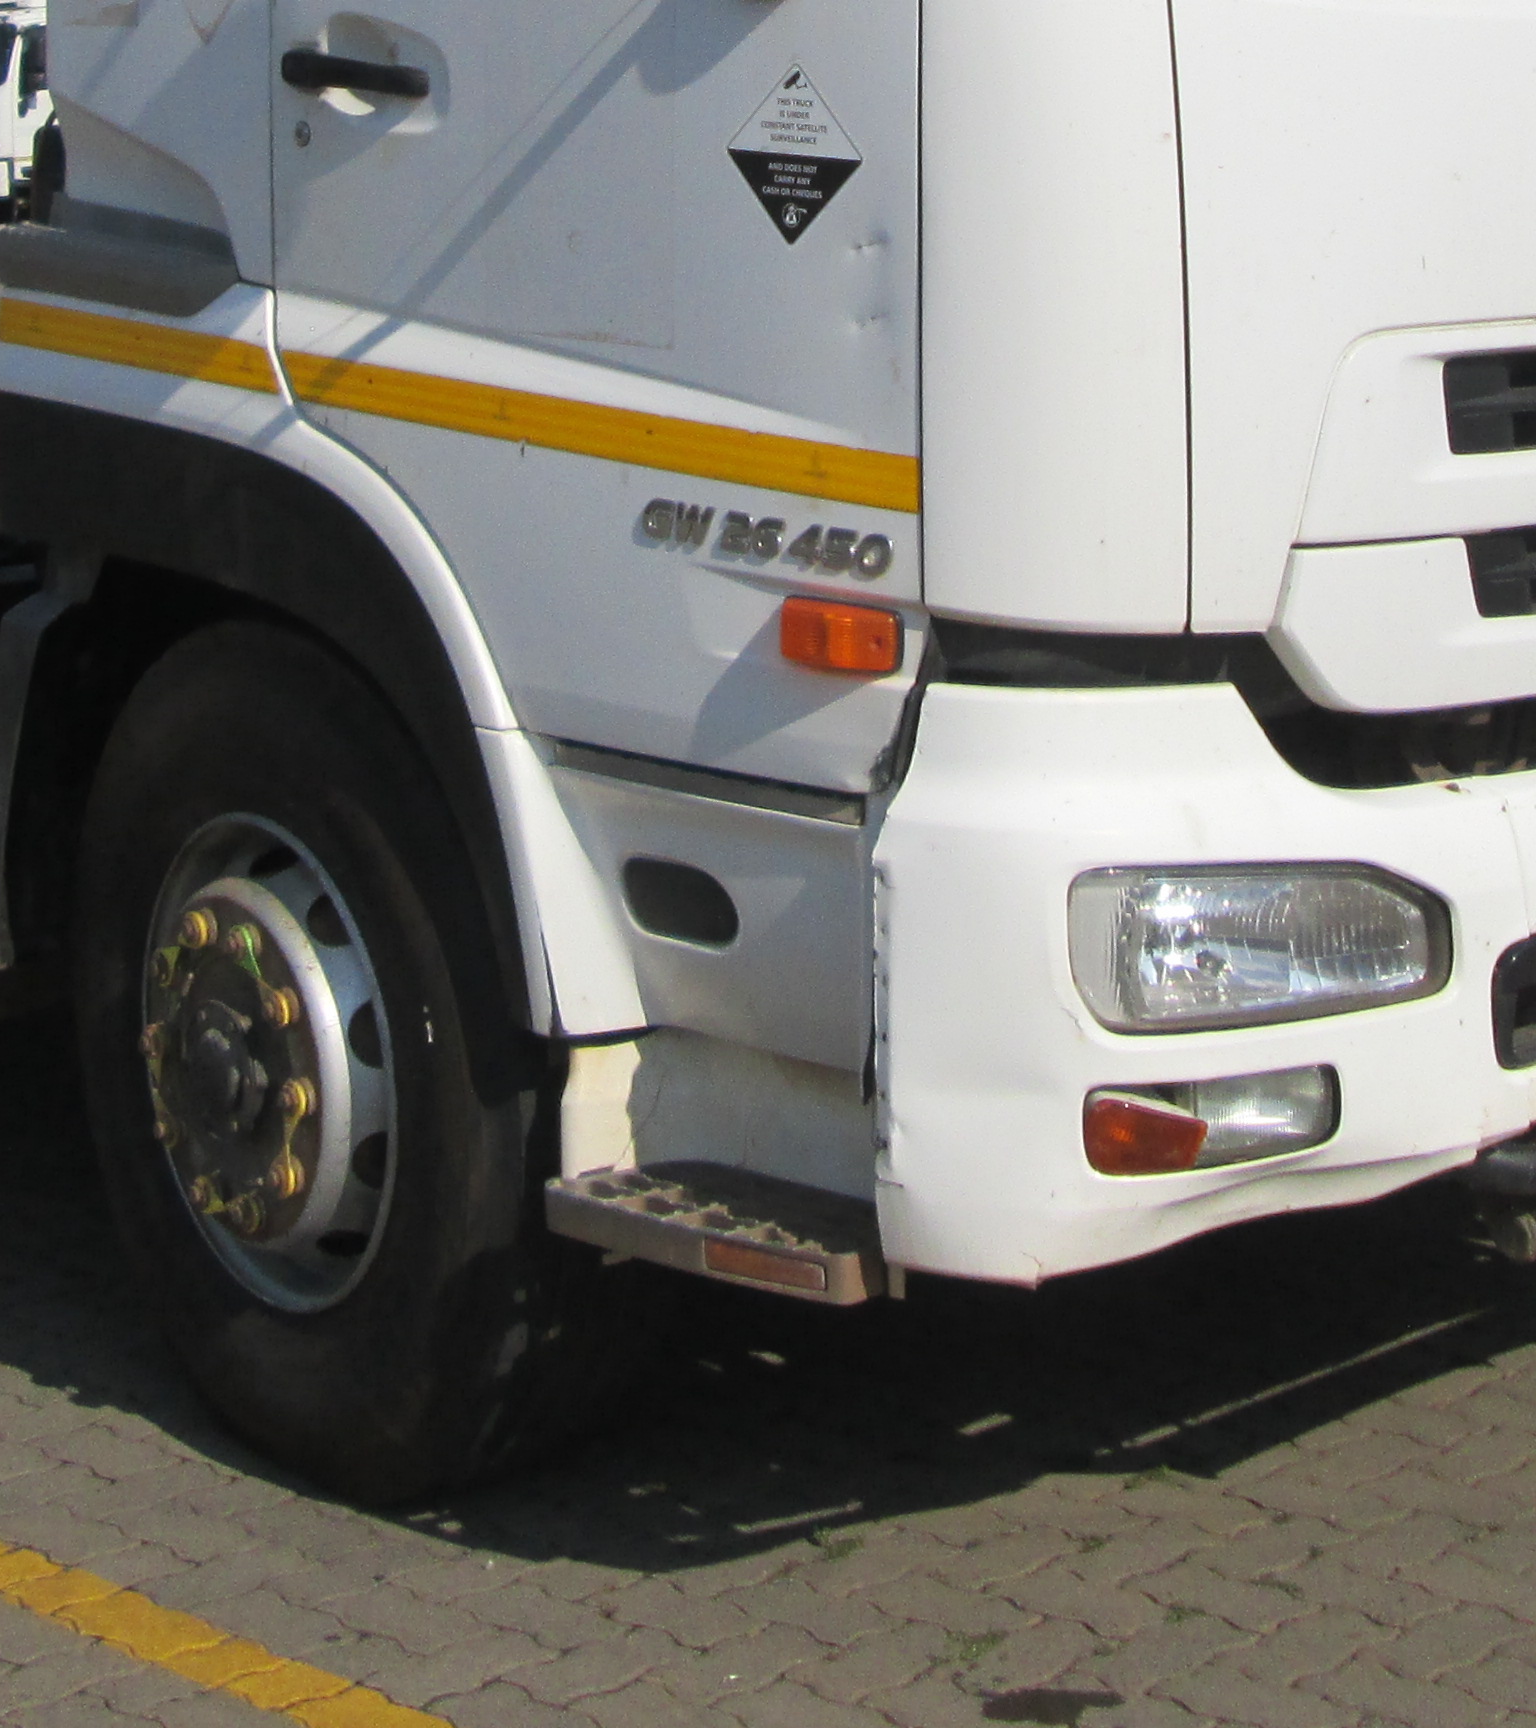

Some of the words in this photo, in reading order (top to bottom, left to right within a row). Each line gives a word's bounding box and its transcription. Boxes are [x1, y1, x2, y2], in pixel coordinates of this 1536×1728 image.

[792, 99, 813, 107] TRUCK
[787, 111, 810, 119] UNDER
[761, 121, 795, 130] CONSTANT
[796, 123, 827, 133] SATELLITE
[770, 134, 817, 145] SURVEILLANCE
[768, 163, 783, 171] AND
[784, 164, 802, 172] DOES
[803, 165, 817, 174] NOT
[774, 175, 795, 183] CARRY
[797, 177, 811, 185] ANY
[763, 186, 780, 195] CASH
[642, 497, 716, 547] GW
[720, 510, 786, 559] 26
[788, 524, 895, 577] 450
